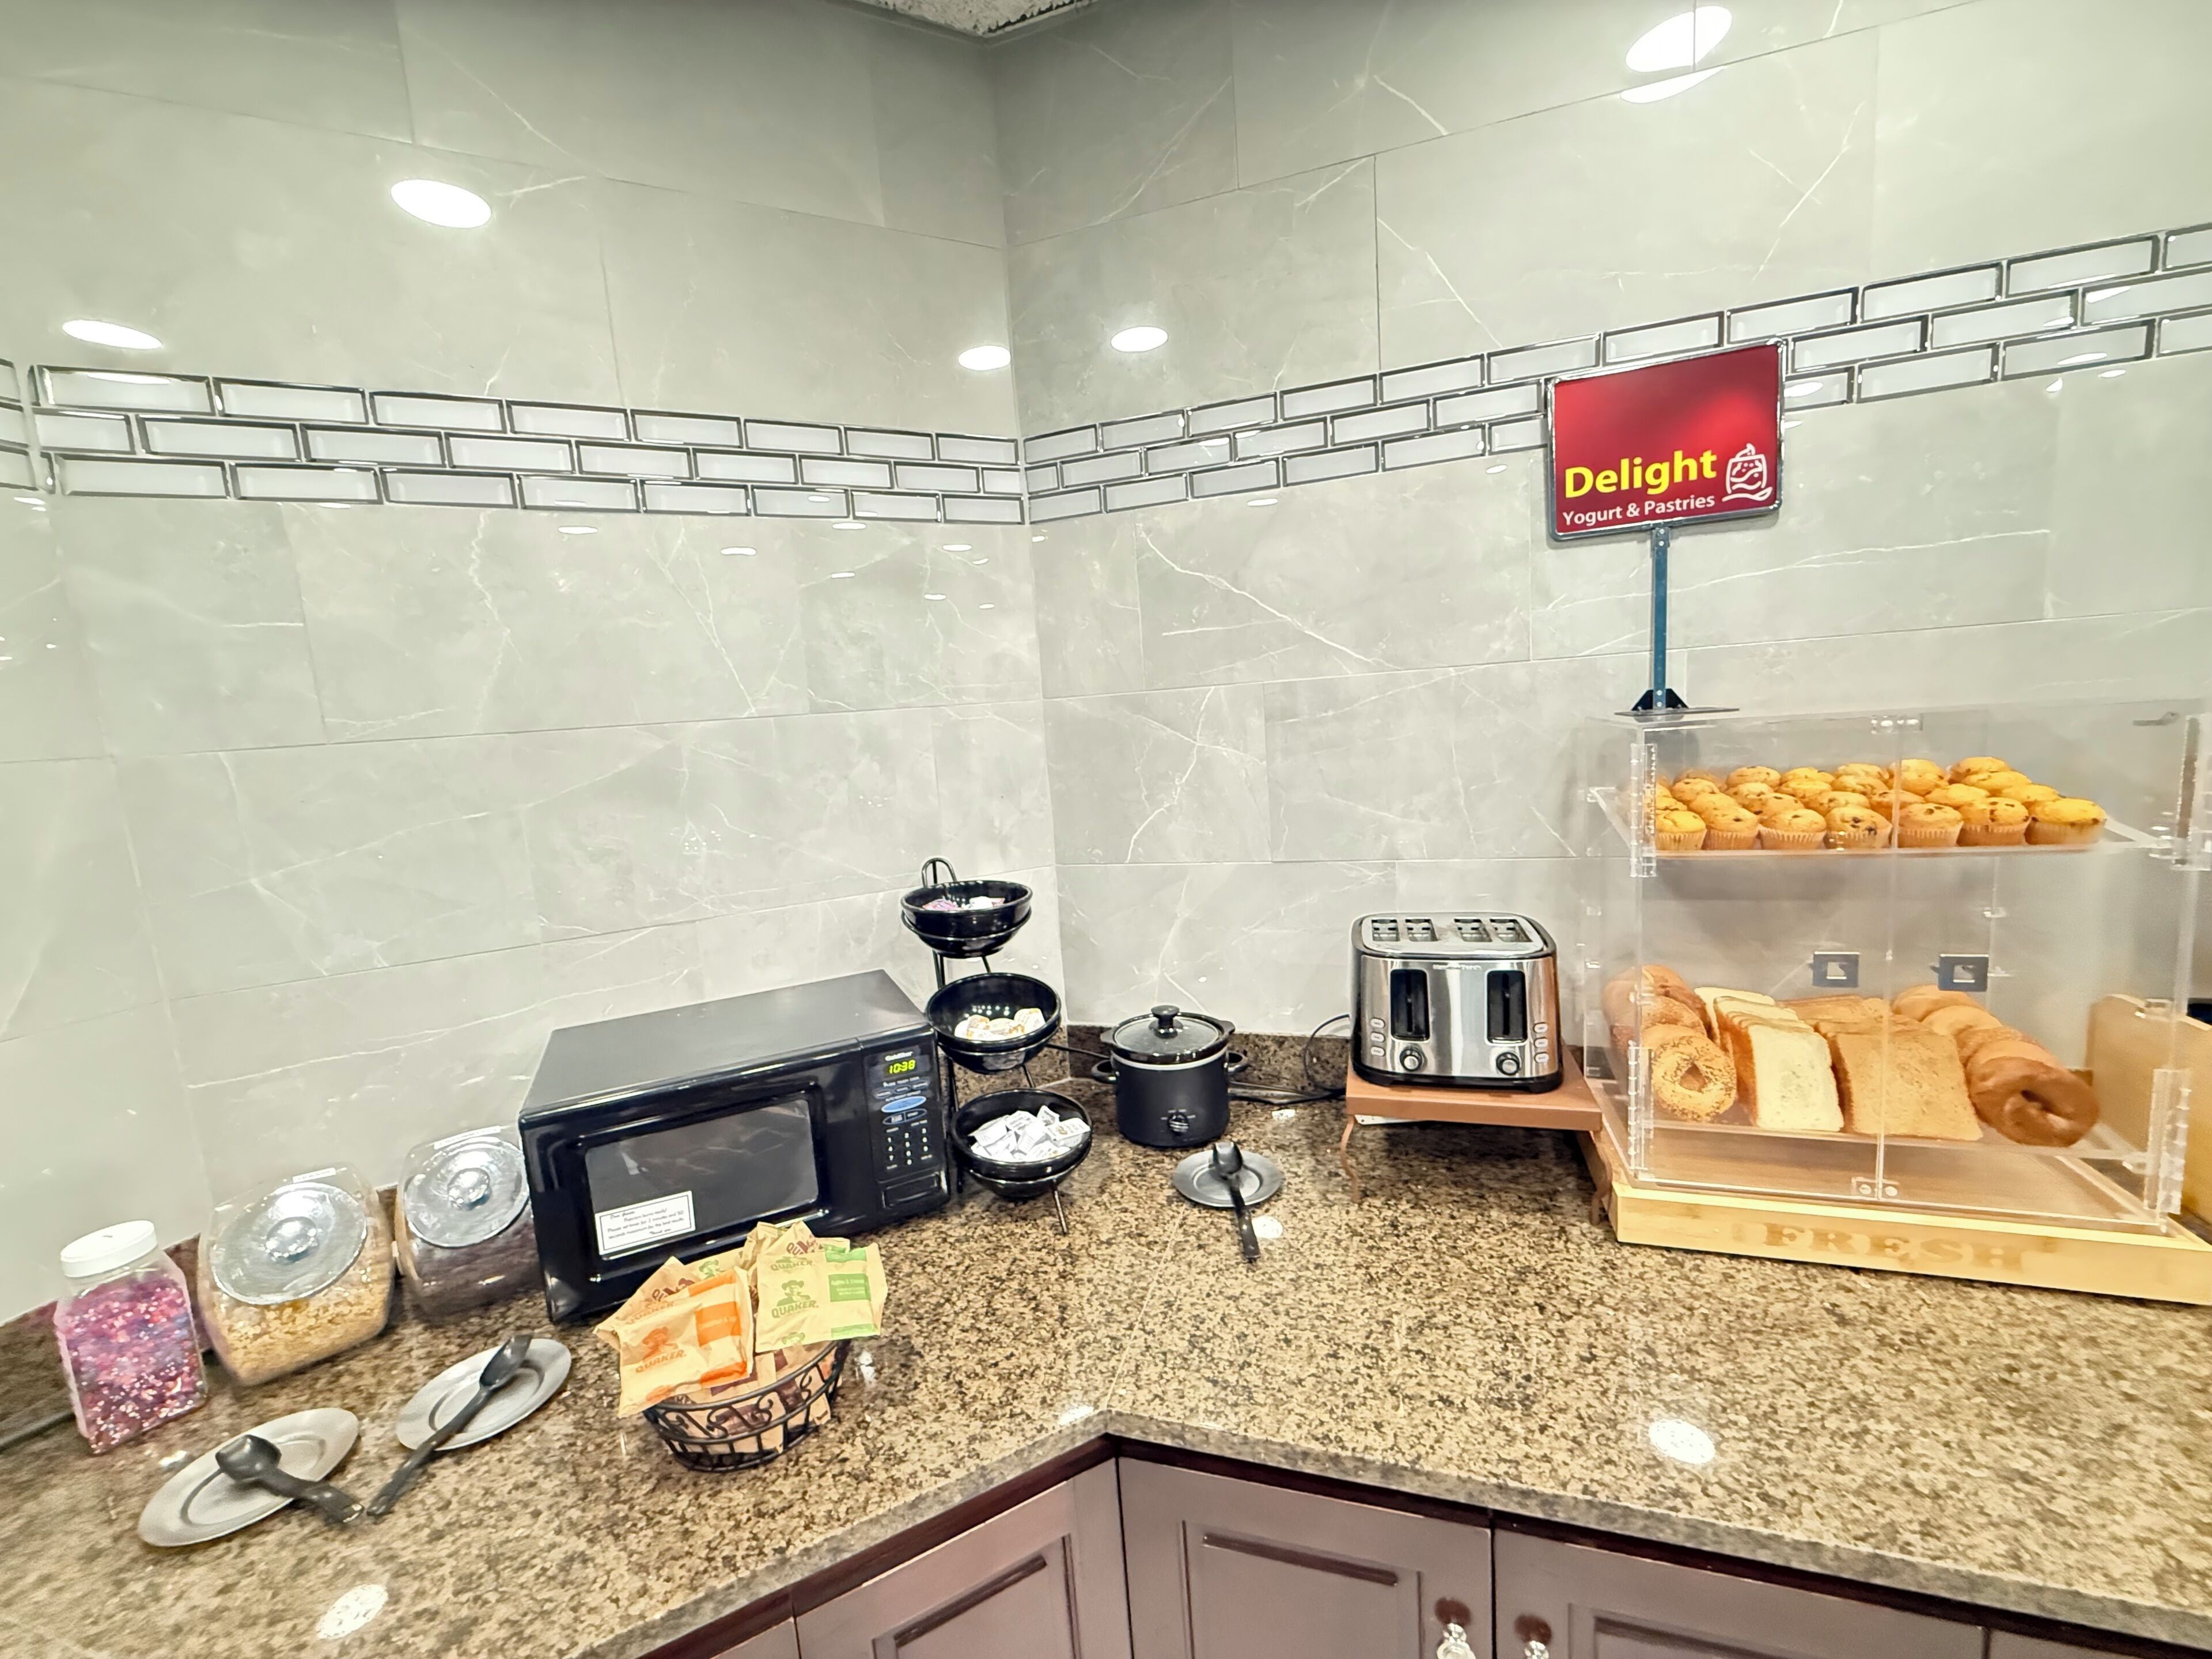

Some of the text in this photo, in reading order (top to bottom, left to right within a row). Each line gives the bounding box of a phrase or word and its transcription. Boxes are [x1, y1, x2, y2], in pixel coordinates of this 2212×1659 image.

[1565, 450, 1717, 498] Delight
[1563, 495, 1715, 527] Yogurt & Pastries
[889, 1060, 916, 1074] 10:38
[1764, 1222, 2022, 1271] FRESH
[771, 1300, 817, 1319] QUAKER
